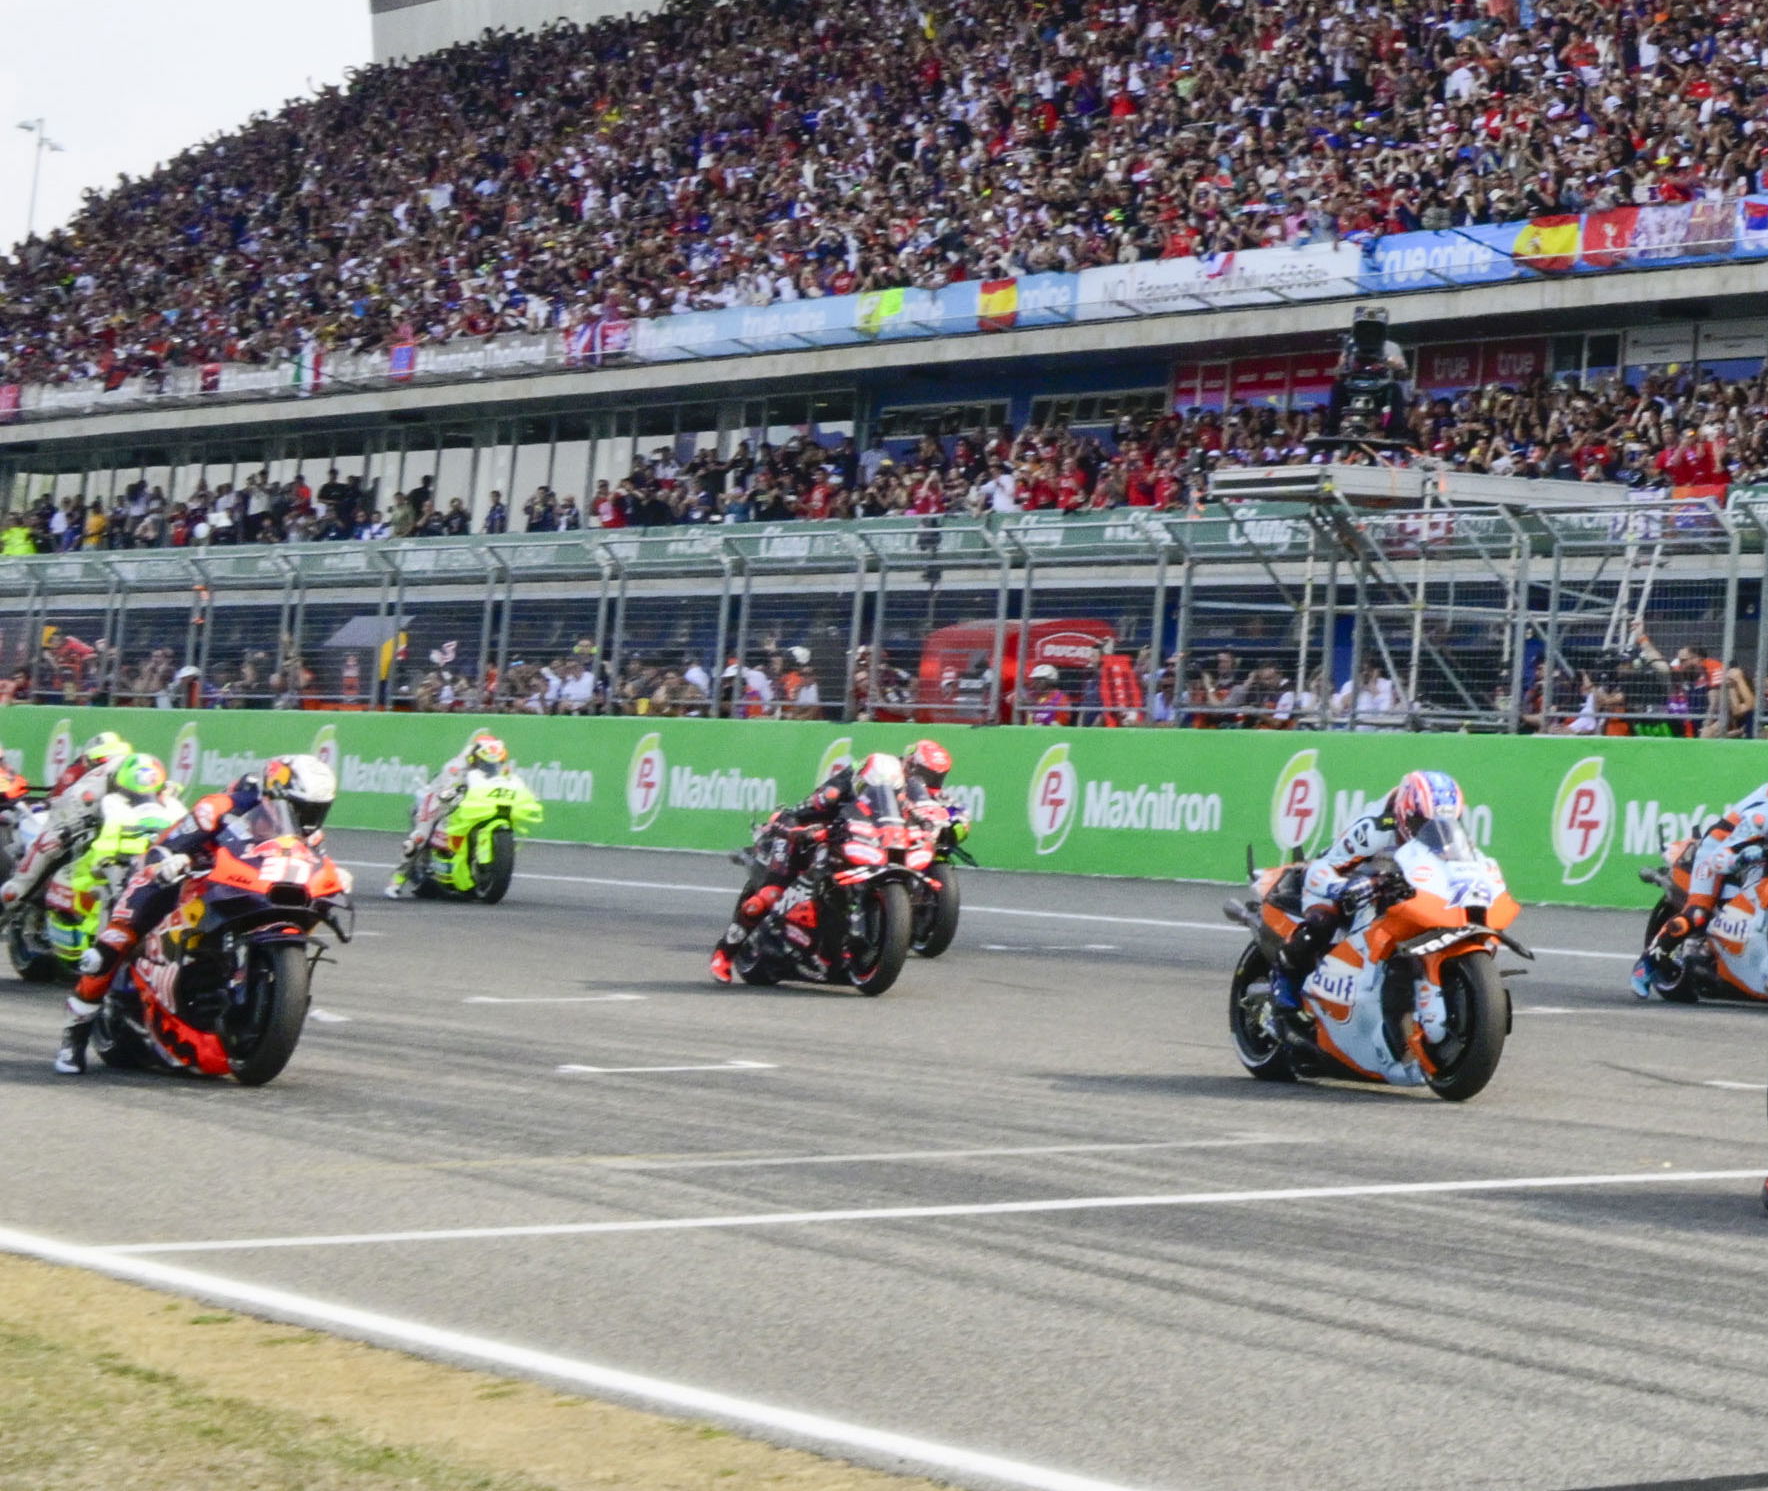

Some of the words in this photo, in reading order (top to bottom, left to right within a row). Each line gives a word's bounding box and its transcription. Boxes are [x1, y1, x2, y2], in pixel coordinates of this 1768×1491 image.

[669, 765, 777, 811] Maxnitron
[1084, 780, 1222, 832] Maxnitron
[1286, 779, 1312, 841] PT
[1569, 789, 1600, 855] PT
